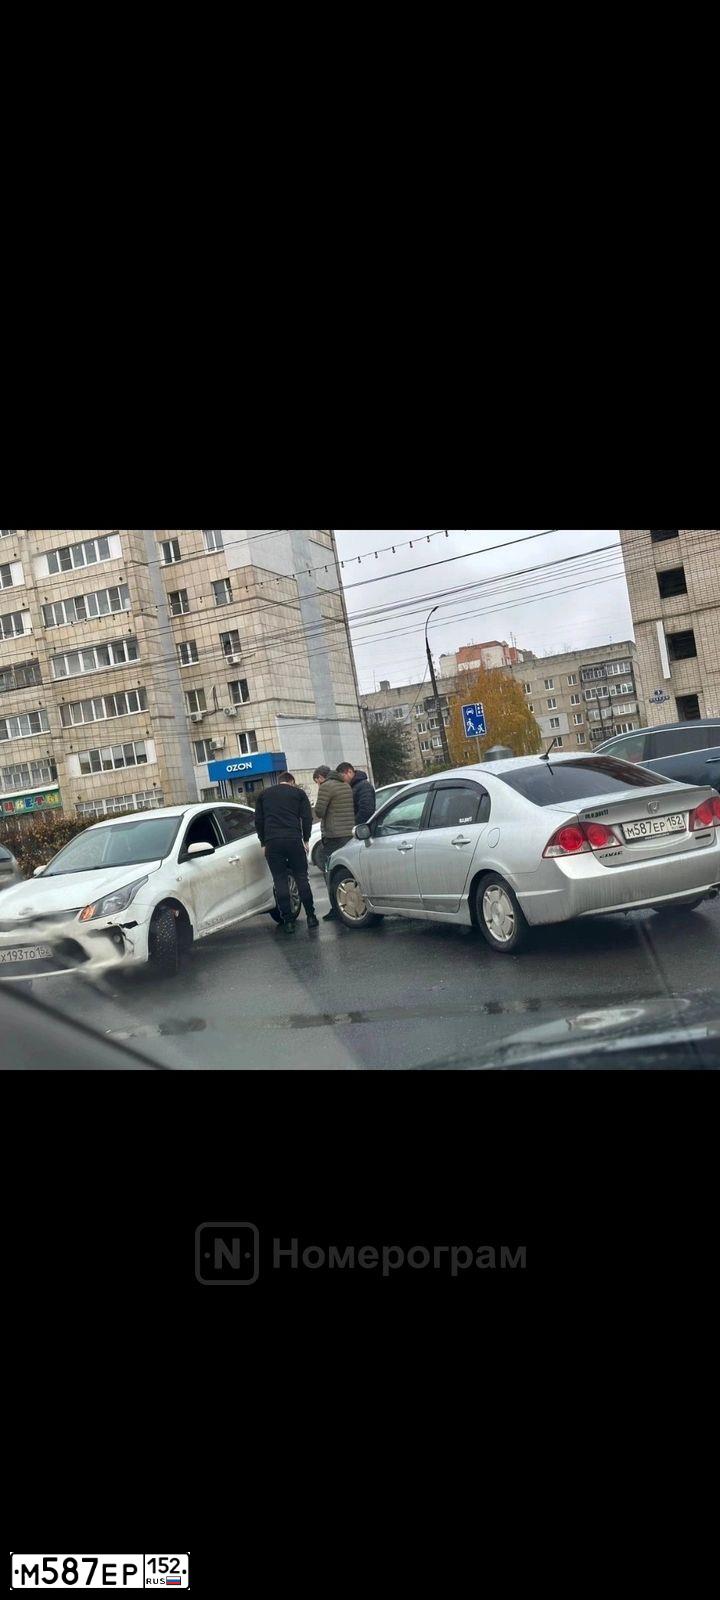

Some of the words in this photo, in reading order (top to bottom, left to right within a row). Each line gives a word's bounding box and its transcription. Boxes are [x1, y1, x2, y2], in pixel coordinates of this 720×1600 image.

[226, 762, 253, 773] OZON
[626, 821, 665, 838] М587ЕР
[666, 815, 682, 827] 152
